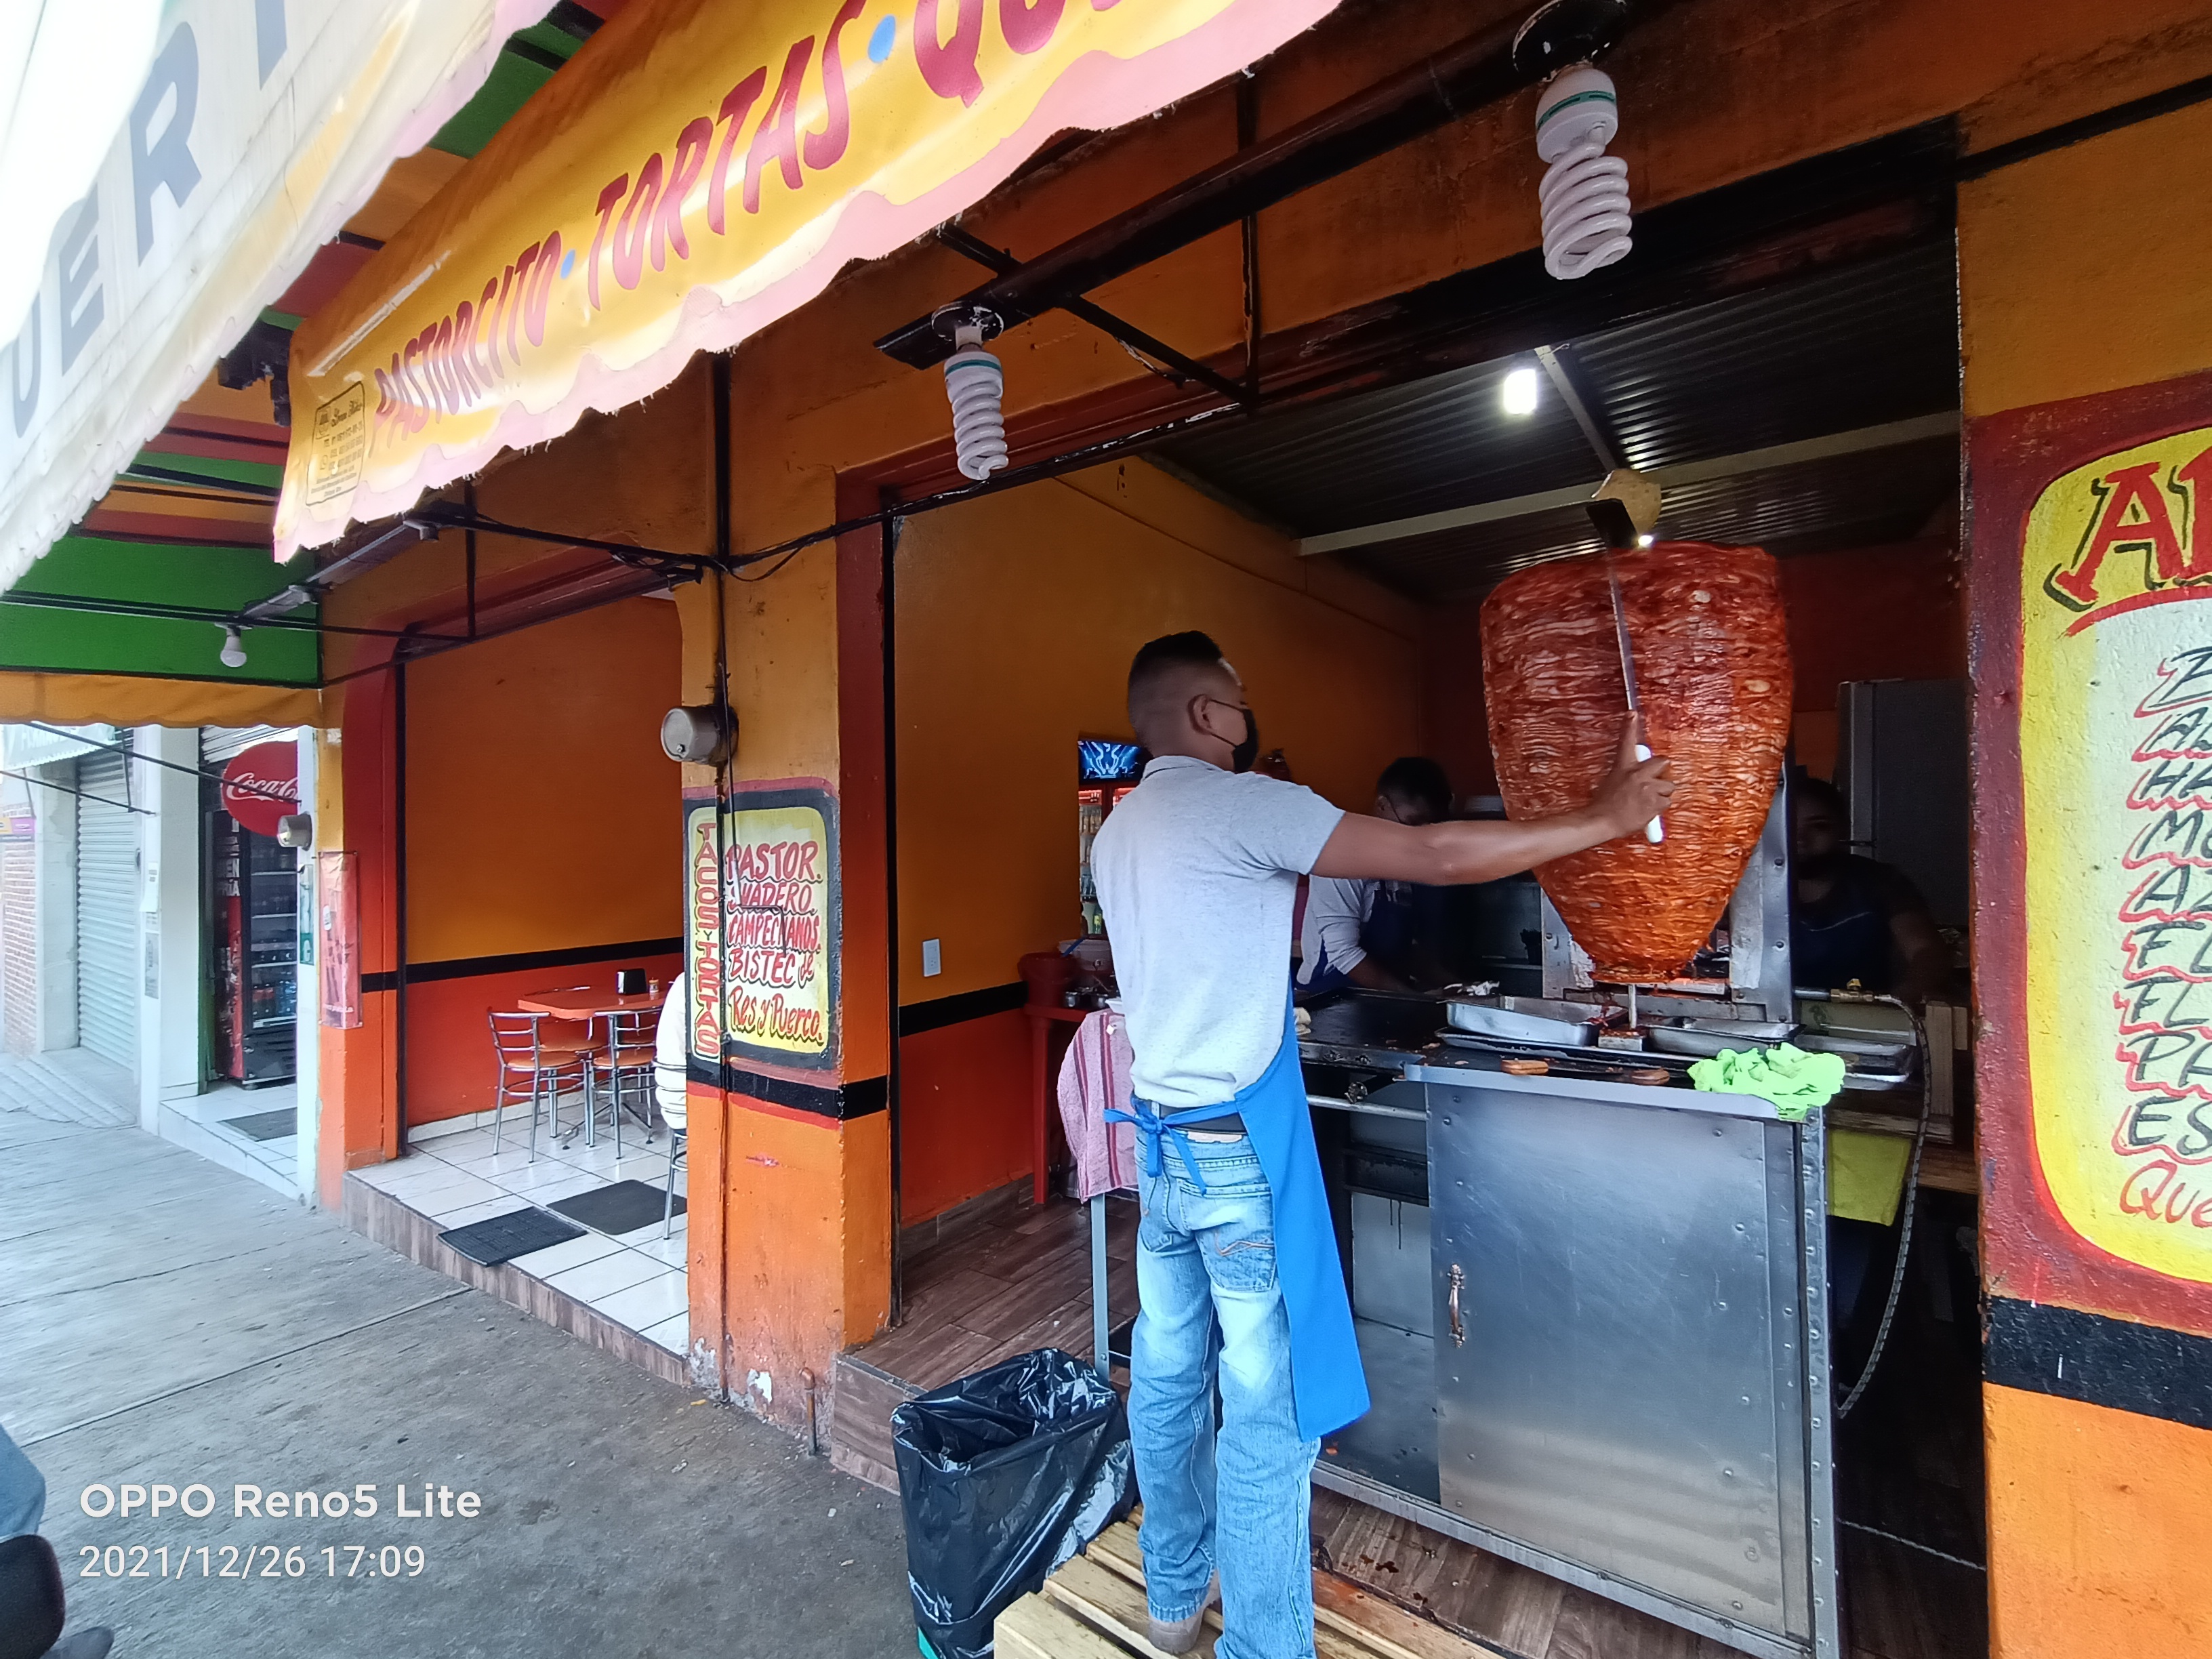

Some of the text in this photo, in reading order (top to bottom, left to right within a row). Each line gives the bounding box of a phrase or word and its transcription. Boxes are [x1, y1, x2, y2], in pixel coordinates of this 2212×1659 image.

[12, 0, 288, 439] UER
[368, 230, 561, 458] PASTORCITO
[588, 0, 866, 311] TORTAS
[696, 822, 719, 930] TACOS
[696, 941, 720, 1054] TORTAS
[729, 947, 815, 983] BISTEC de
[729, 985, 757, 1027] Res
[760, 999, 771, 1030] y
